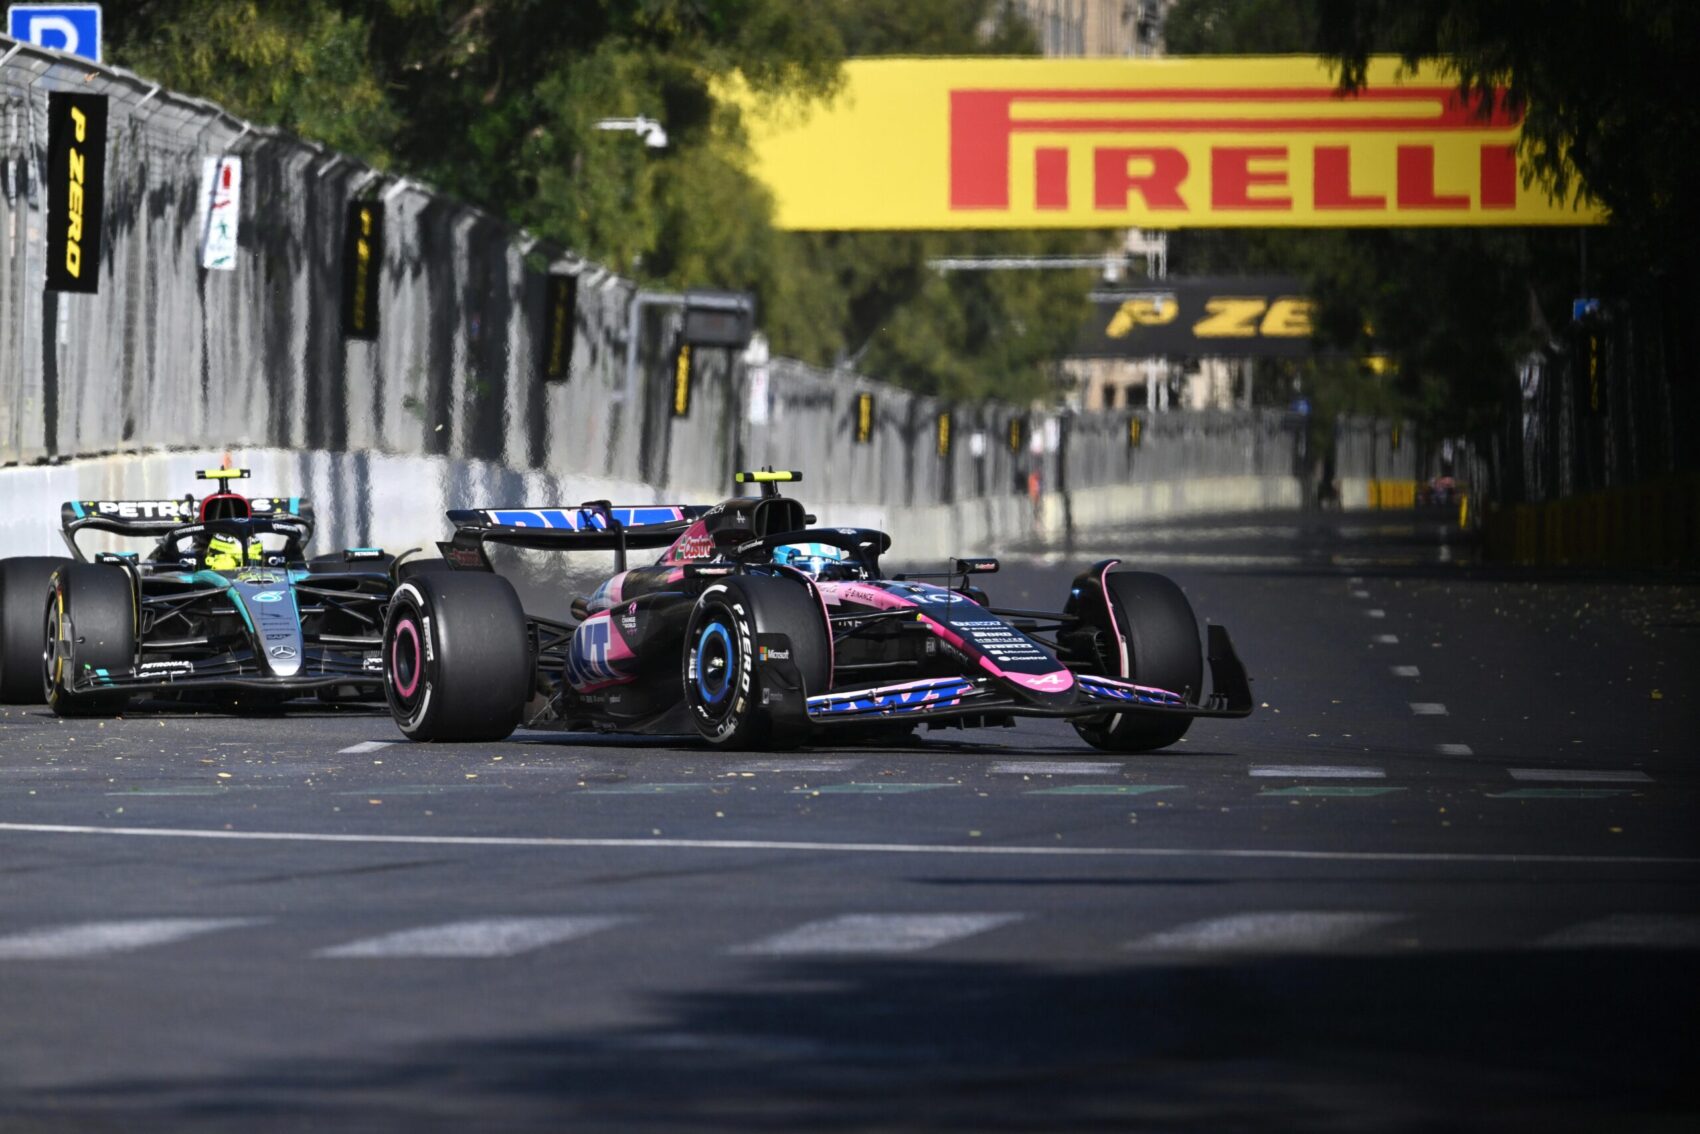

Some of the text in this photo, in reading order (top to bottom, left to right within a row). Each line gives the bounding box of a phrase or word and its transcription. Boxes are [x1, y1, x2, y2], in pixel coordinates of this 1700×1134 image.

[948, 88, 1526, 211] PIRELLI
[66, 106, 86, 278] P ZERO
[1105, 297, 1316, 338] P ZE
[98, 498, 272, 518] PETROS
[251, 590, 286, 602] 6
[739, 620, 752, 694] ZERO
